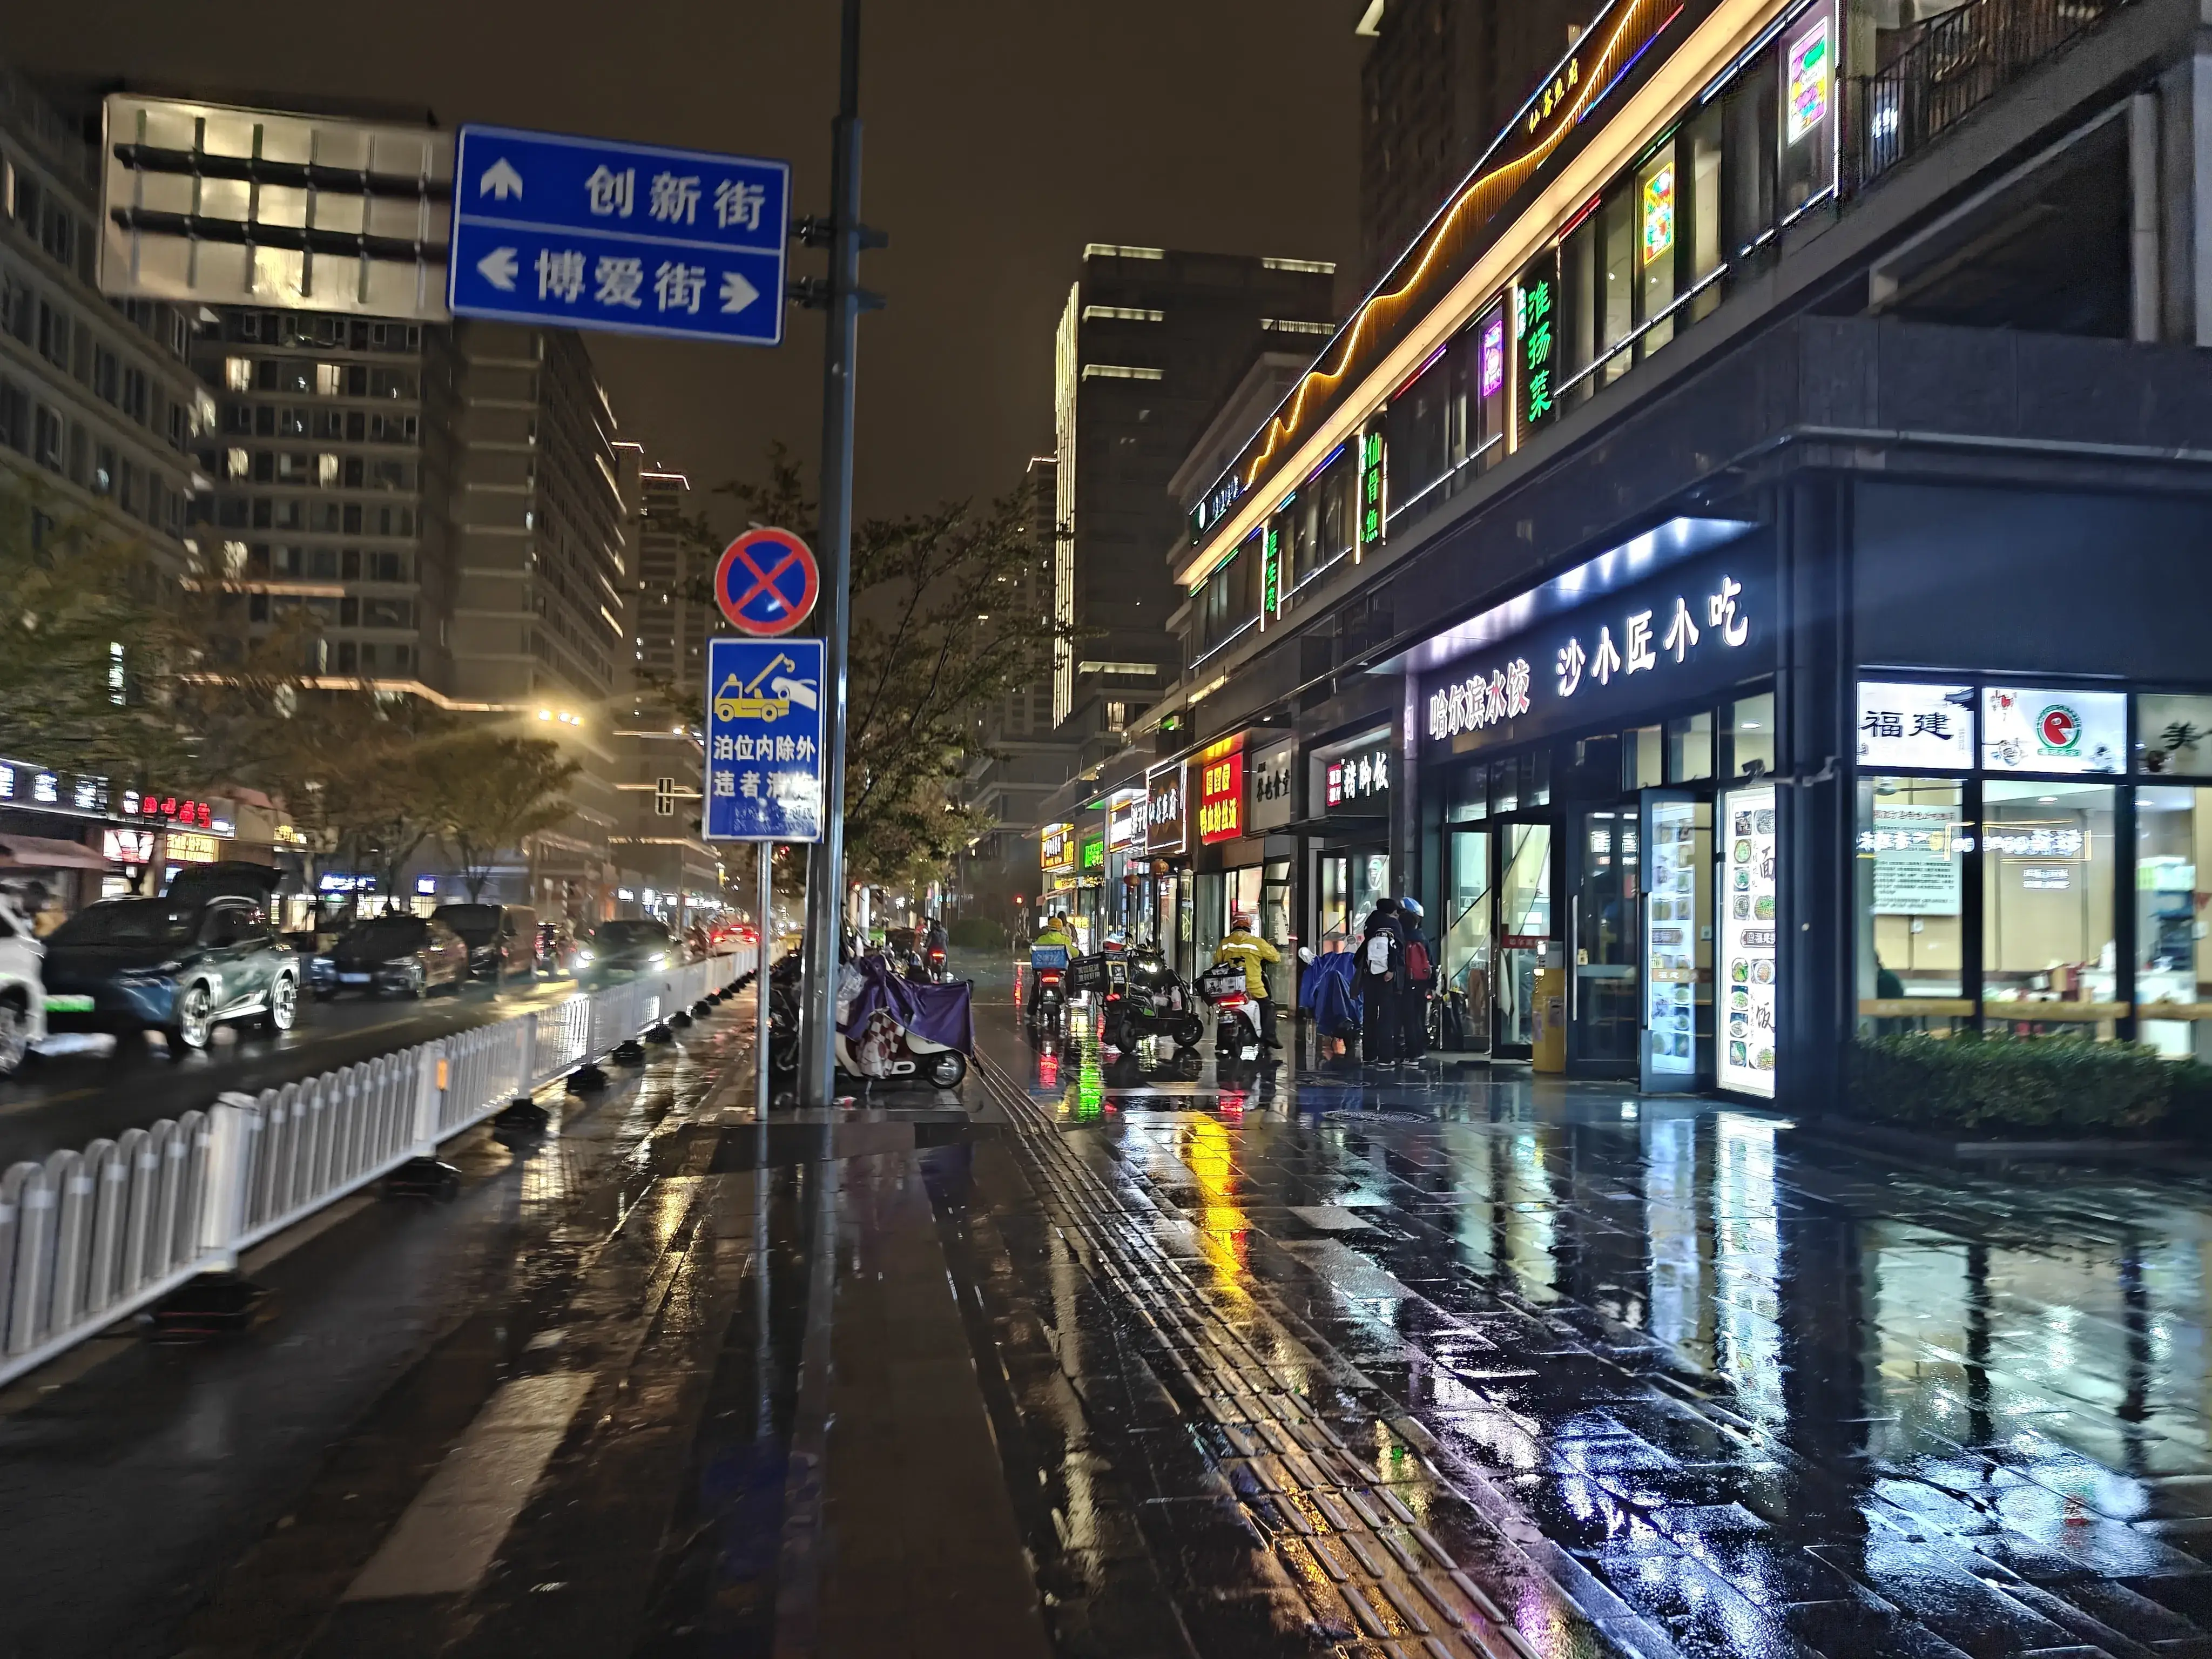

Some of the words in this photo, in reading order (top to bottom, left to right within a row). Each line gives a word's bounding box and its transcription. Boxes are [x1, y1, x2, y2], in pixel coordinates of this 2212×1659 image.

[585, 165, 765, 232] 创新街
[535, 248, 706, 315] 博爱街
[1528, 280, 1552, 422] 淮扬菜
[1556, 574, 1749, 697] 沙小匠小吃
[1429, 658, 1532, 740] 哈尔滨水饺
[1859, 711, 1954, 740] 福建
[714, 734, 816, 763] 泊位内除外
[1344, 751, 1390, 799] 猪脚饭
[713, 770, 817, 800] 违者清
[1199, 797, 1237, 837] 鸭血粉丝汤
